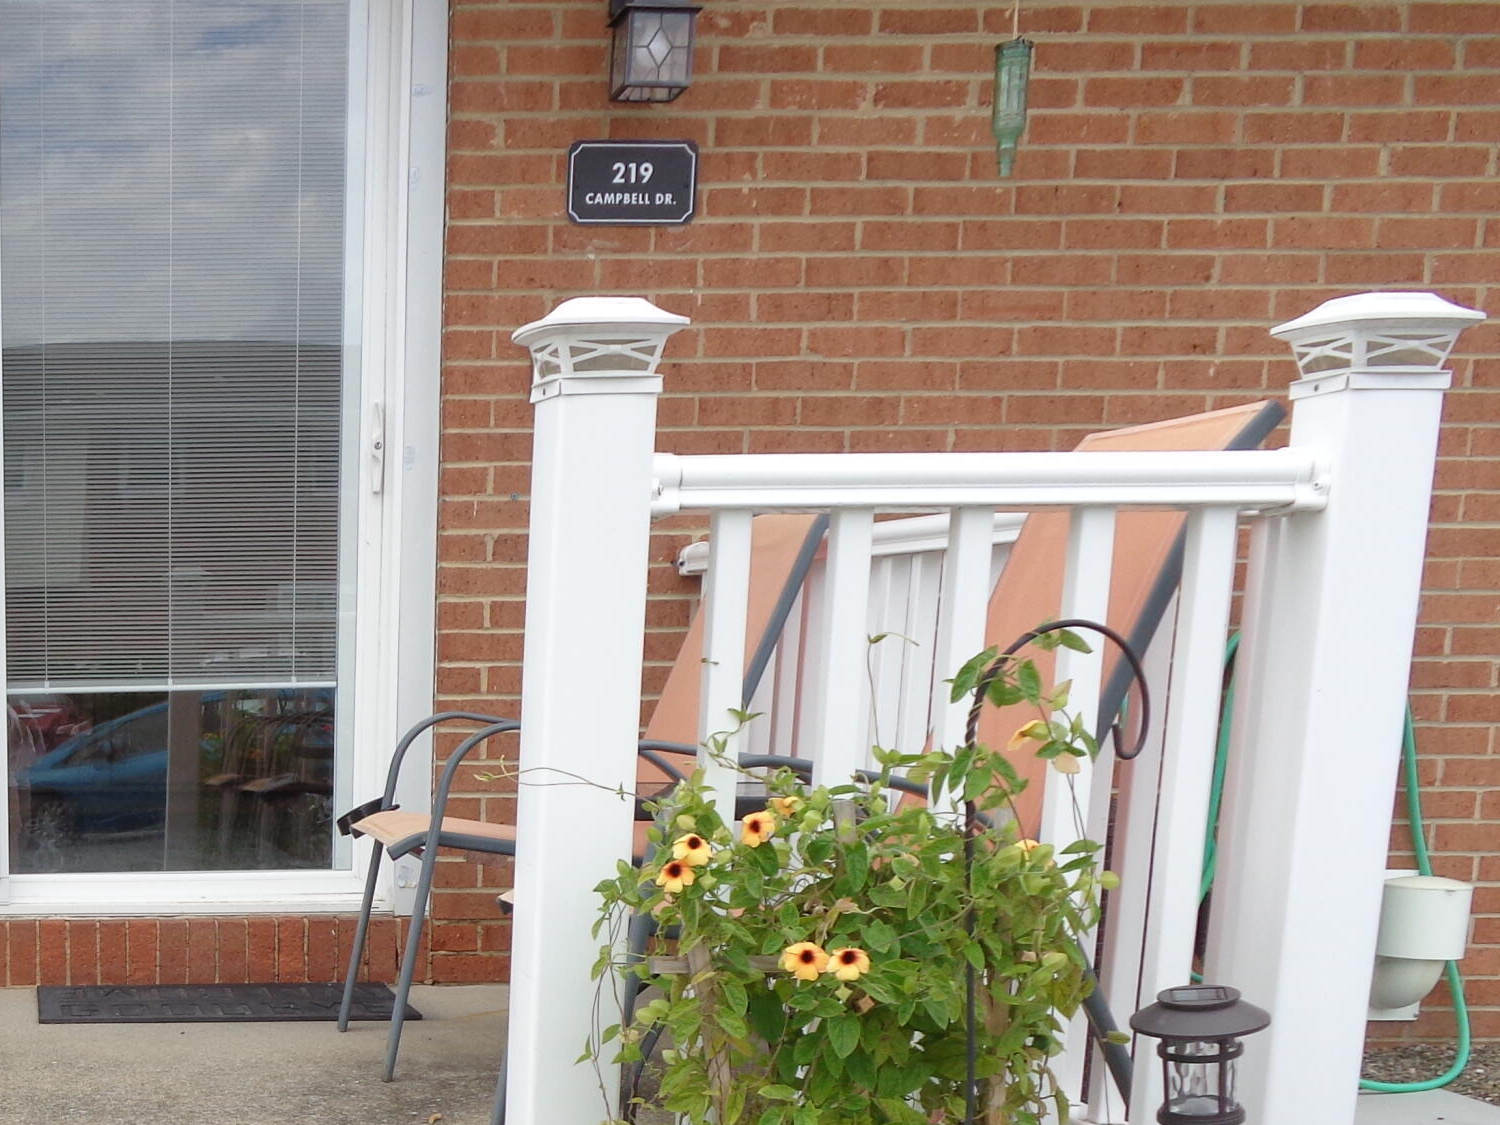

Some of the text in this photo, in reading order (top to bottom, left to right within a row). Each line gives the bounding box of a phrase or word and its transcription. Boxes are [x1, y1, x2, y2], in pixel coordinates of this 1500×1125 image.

[611, 162, 654, 184] 219
[585, 192, 677, 205] CAMPBELL DR.
